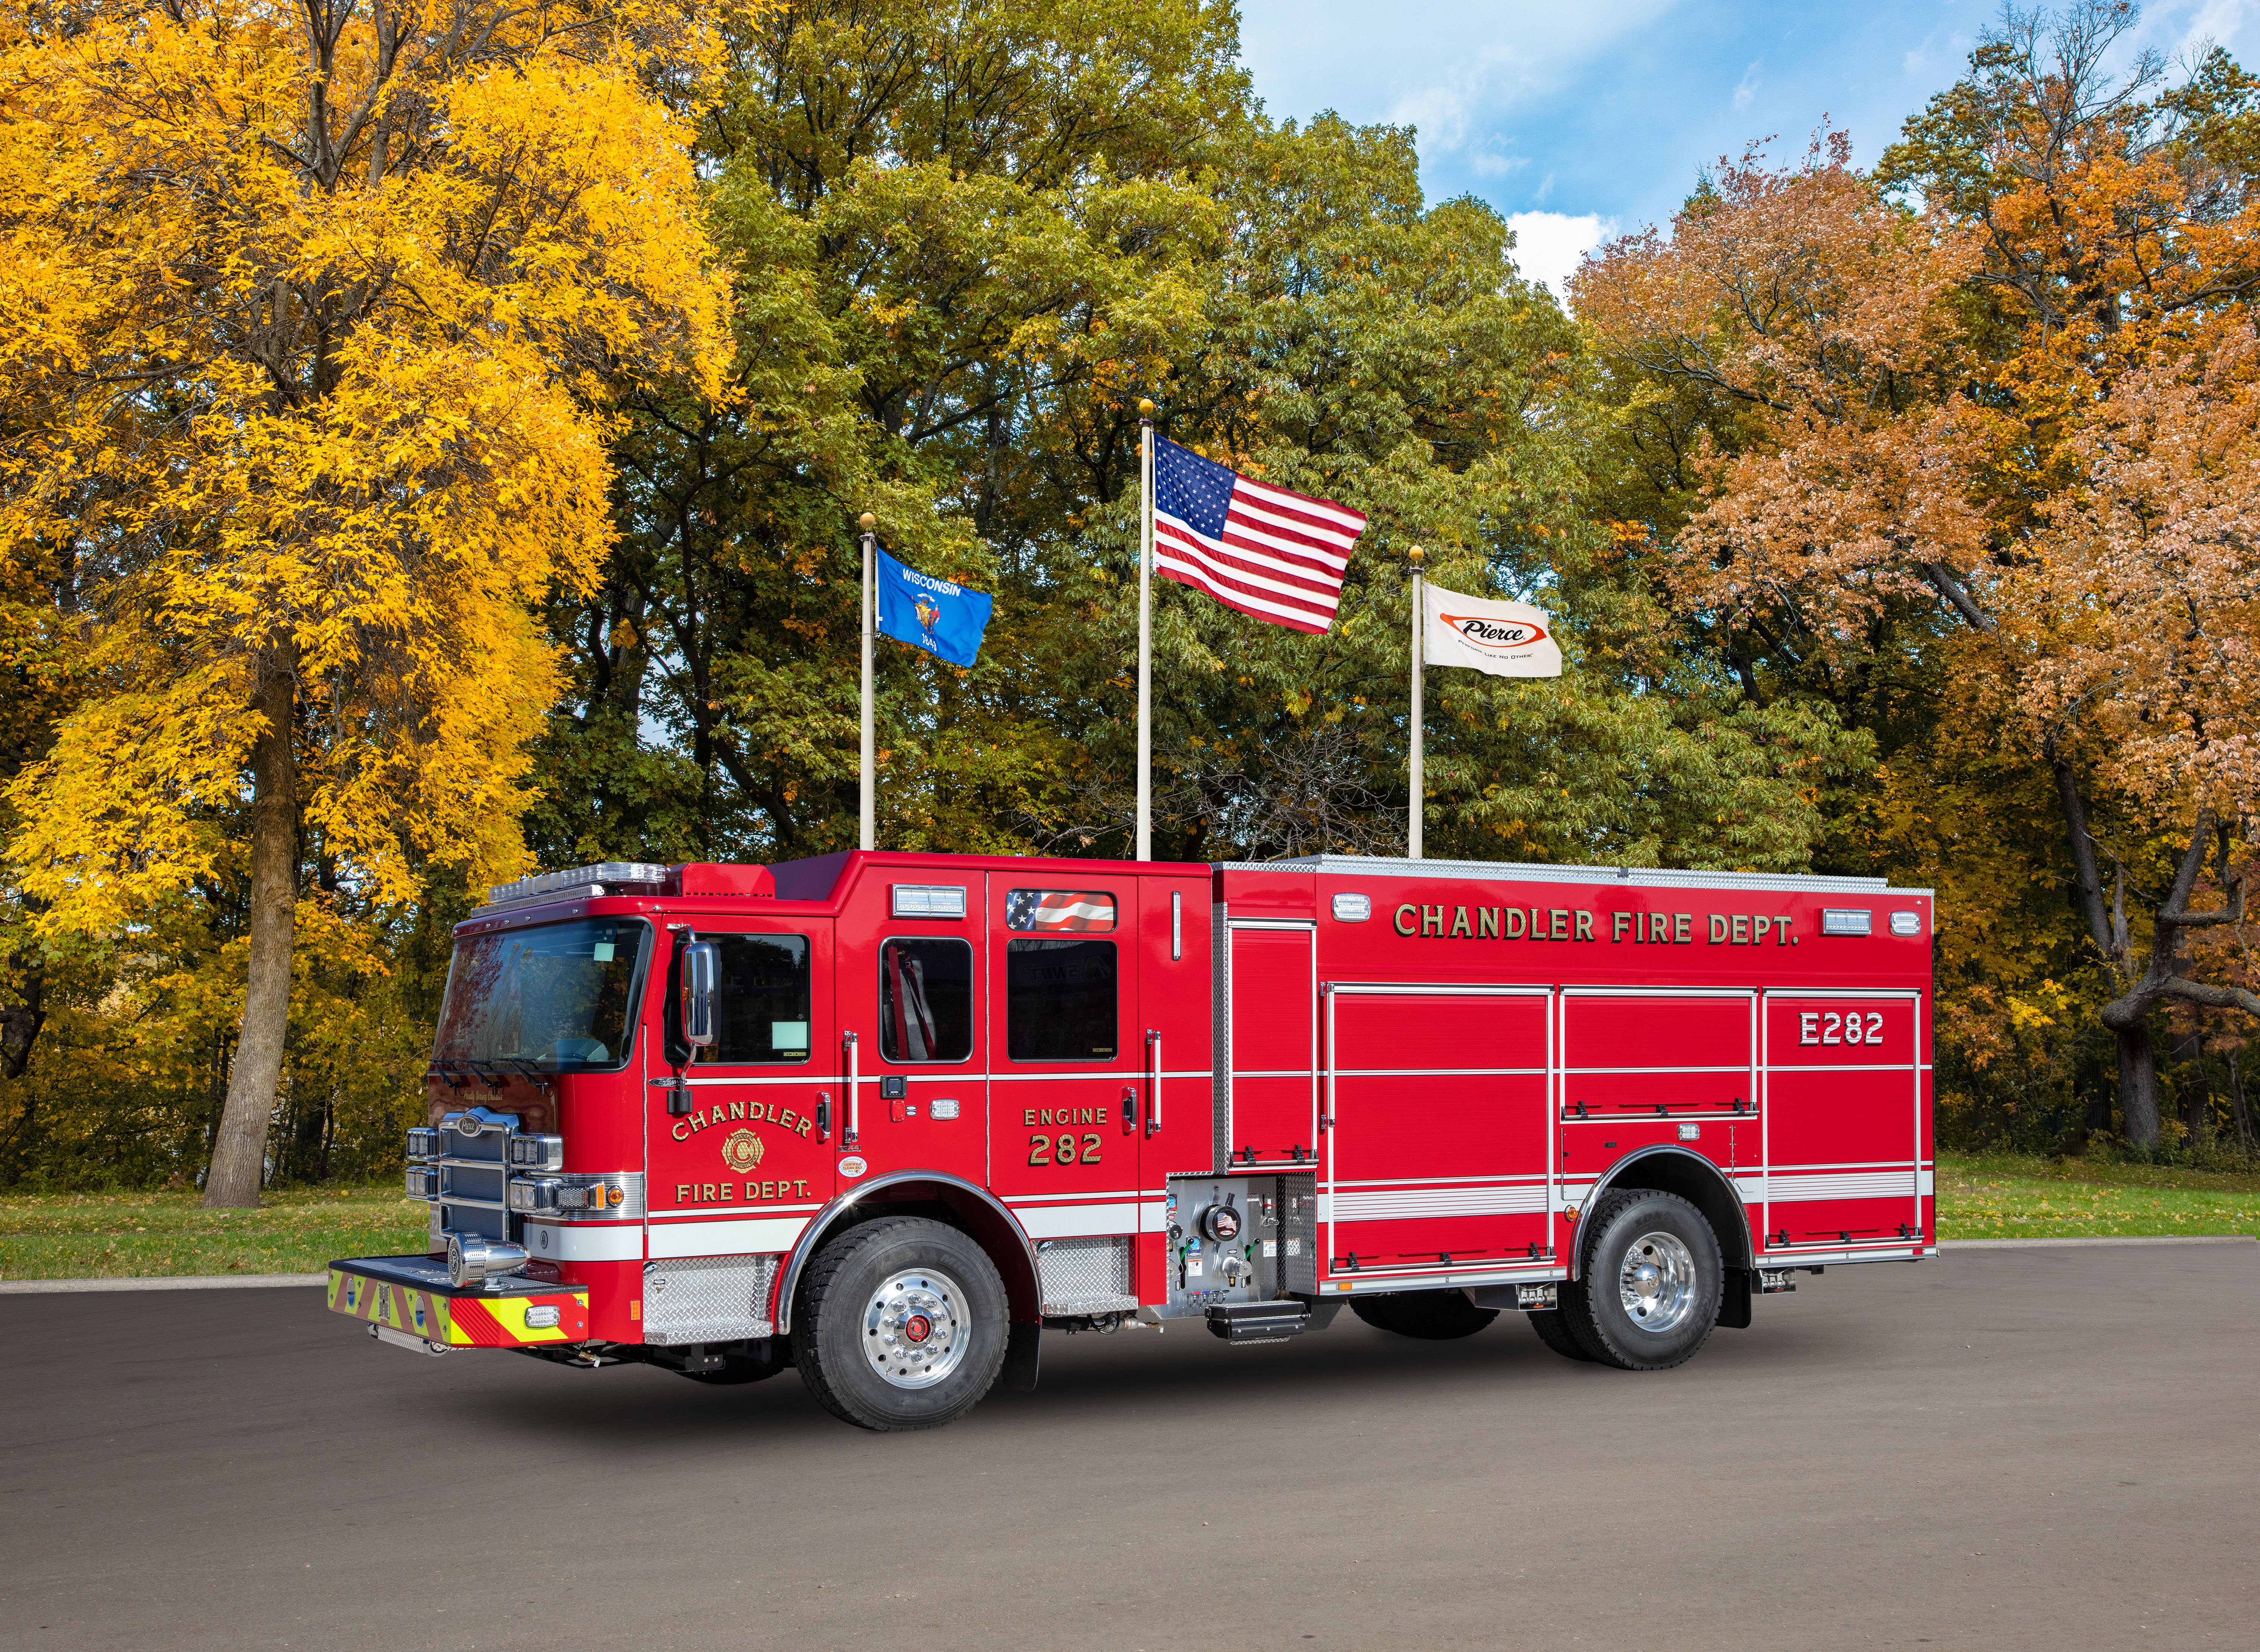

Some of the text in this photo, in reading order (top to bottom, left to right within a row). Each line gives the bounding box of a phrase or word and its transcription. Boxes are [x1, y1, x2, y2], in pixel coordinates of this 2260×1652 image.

[903, 568, 961, 597] WISCONSIN
[922, 633, 937, 651] 1848
[1463, 620, 1524, 641] Pierce
[1458, 639, 1483, 654] PERFORM.
[1393, 903, 1800, 946] CHANDLER FIRE DEPT.
[1799, 1011, 1884, 1046] E282
[464, 1090, 475, 1104] Proudly
[476, 1091, 487, 1104] Serving
[462, 1119, 475, 1131] Pierce
[672, 1101, 812, 1142] CHANDLER
[1023, 1107, 1107, 1126] ENGINE
[734, 1155, 758, 1167] DEPARTMENT
[1028, 1132, 1102, 1166] 282
[675, 1179, 811, 1204] FIRE DEPT.
[939, 1251, 991, 1318] MICHELIN
[1677, 1277, 1712, 1348] MICHELIN
